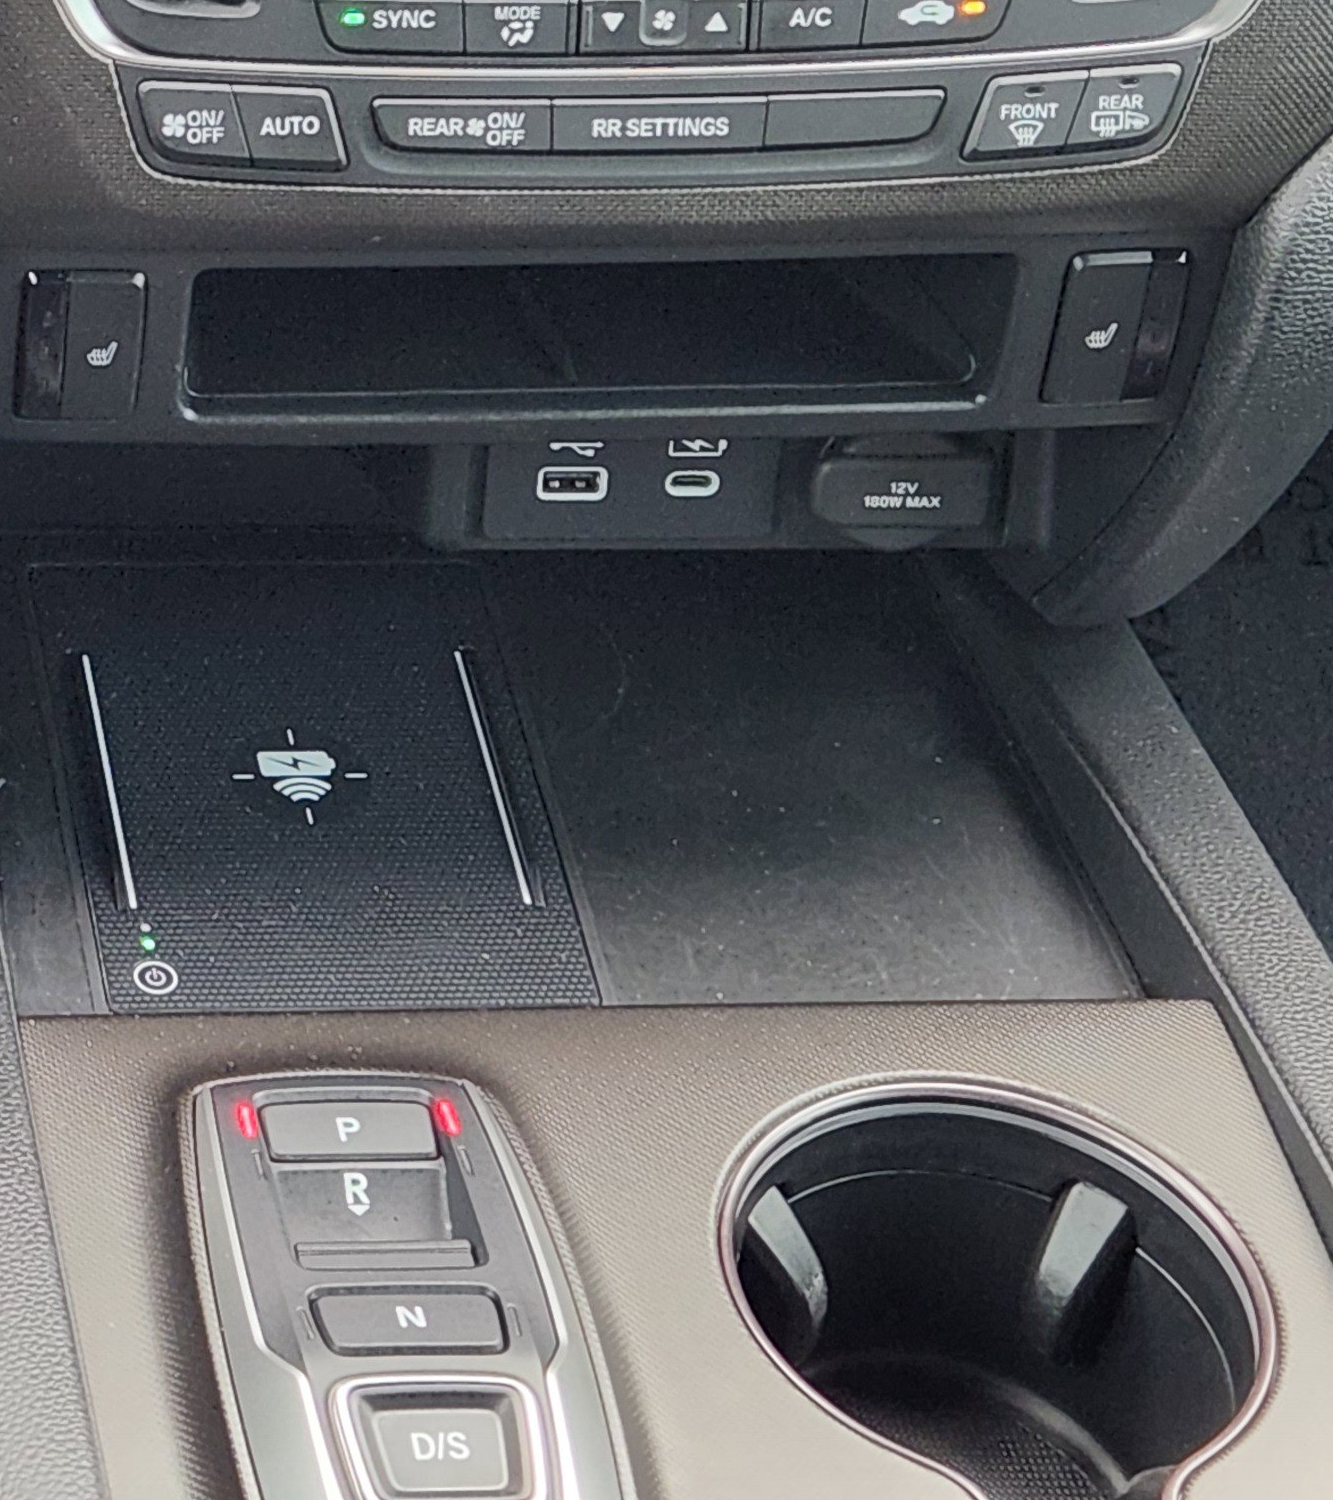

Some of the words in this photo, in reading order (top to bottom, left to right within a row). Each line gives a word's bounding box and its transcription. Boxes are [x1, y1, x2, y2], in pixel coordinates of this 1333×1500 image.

[372, 8, 437, 30] SYNC
[494, 5, 542, 22] MODE
[788, 6, 833, 28] A/C
[1000, 101, 1060, 122] FRONT
[1098, 93, 1145, 112] REAR
[186, 108, 225, 129] ON/
[259, 115, 321, 137] AUTO
[407, 116, 464, 138] REAR
[487, 111, 526, 131] ON/
[591, 117, 623, 139] RR
[624, 116, 731, 139] SETTINGS
[186, 125, 226, 146] OFF
[485, 127, 526, 148] OFF
[889, 481, 920, 496] 12V
[906, 495, 942, 509] MAX
[335, 1116, 361, 1143] P
[343, 1172, 371, 1207] R
[395, 1305, 428, 1329] N
[410, 1432, 471, 1461] D/S
